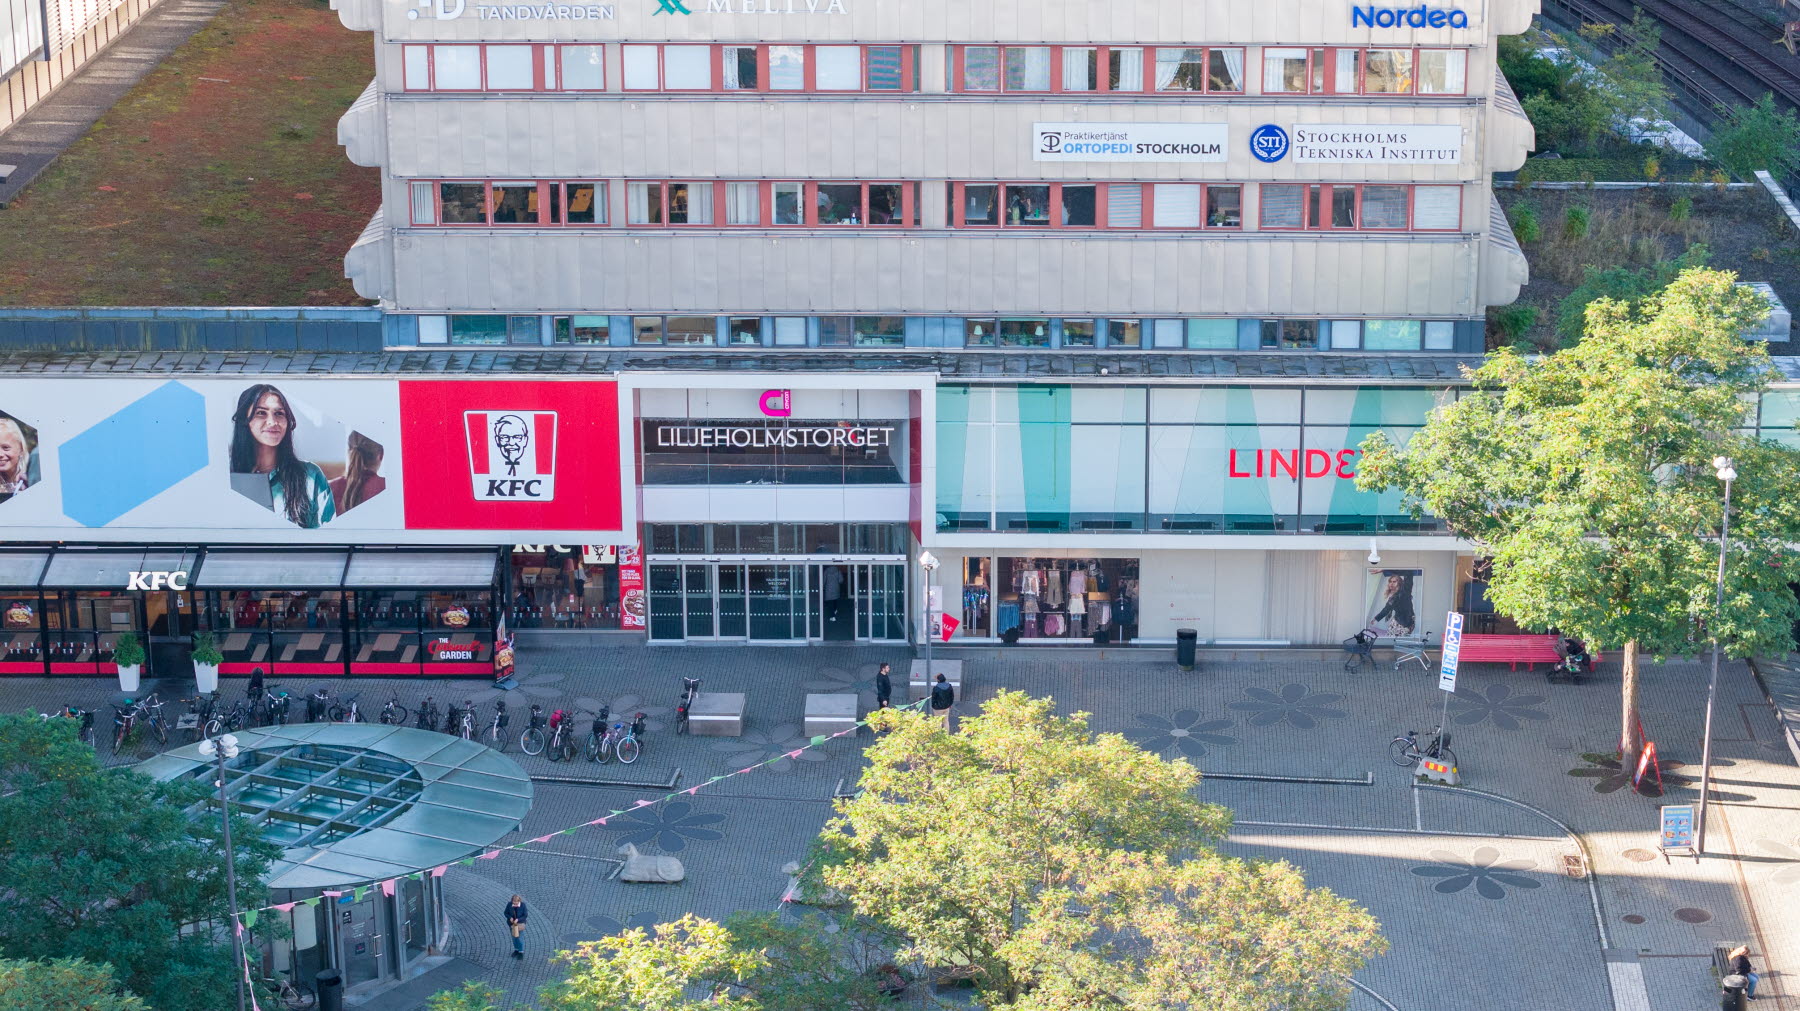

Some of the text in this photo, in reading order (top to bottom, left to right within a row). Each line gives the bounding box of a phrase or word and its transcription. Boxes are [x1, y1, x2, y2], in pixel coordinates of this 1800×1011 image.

[476, 3, 615, 20] TANDVÅRDEN
[704, 0, 848, 14] MELIVA
[1352, 4, 1468, 29] Nordea
[1064, 132, 1128, 142] Praktikertjänst
[1258, 136, 1281, 148] STI
[1296, 130, 1407, 144] STOCKHOLMS
[1063, 143, 1221, 154] ORTOPEDI STOCKHOLM
[1296, 145, 1458, 160] TEKNISKA INSTITUT
[657, 426, 895, 448] LILJEHOLMSTORGET
[1229, 448, 1364, 479] LINDE
[486, 480, 542, 497] KFC
[126, 571, 187, 591] KFC
[440, 650, 472, 660] GARDEN
